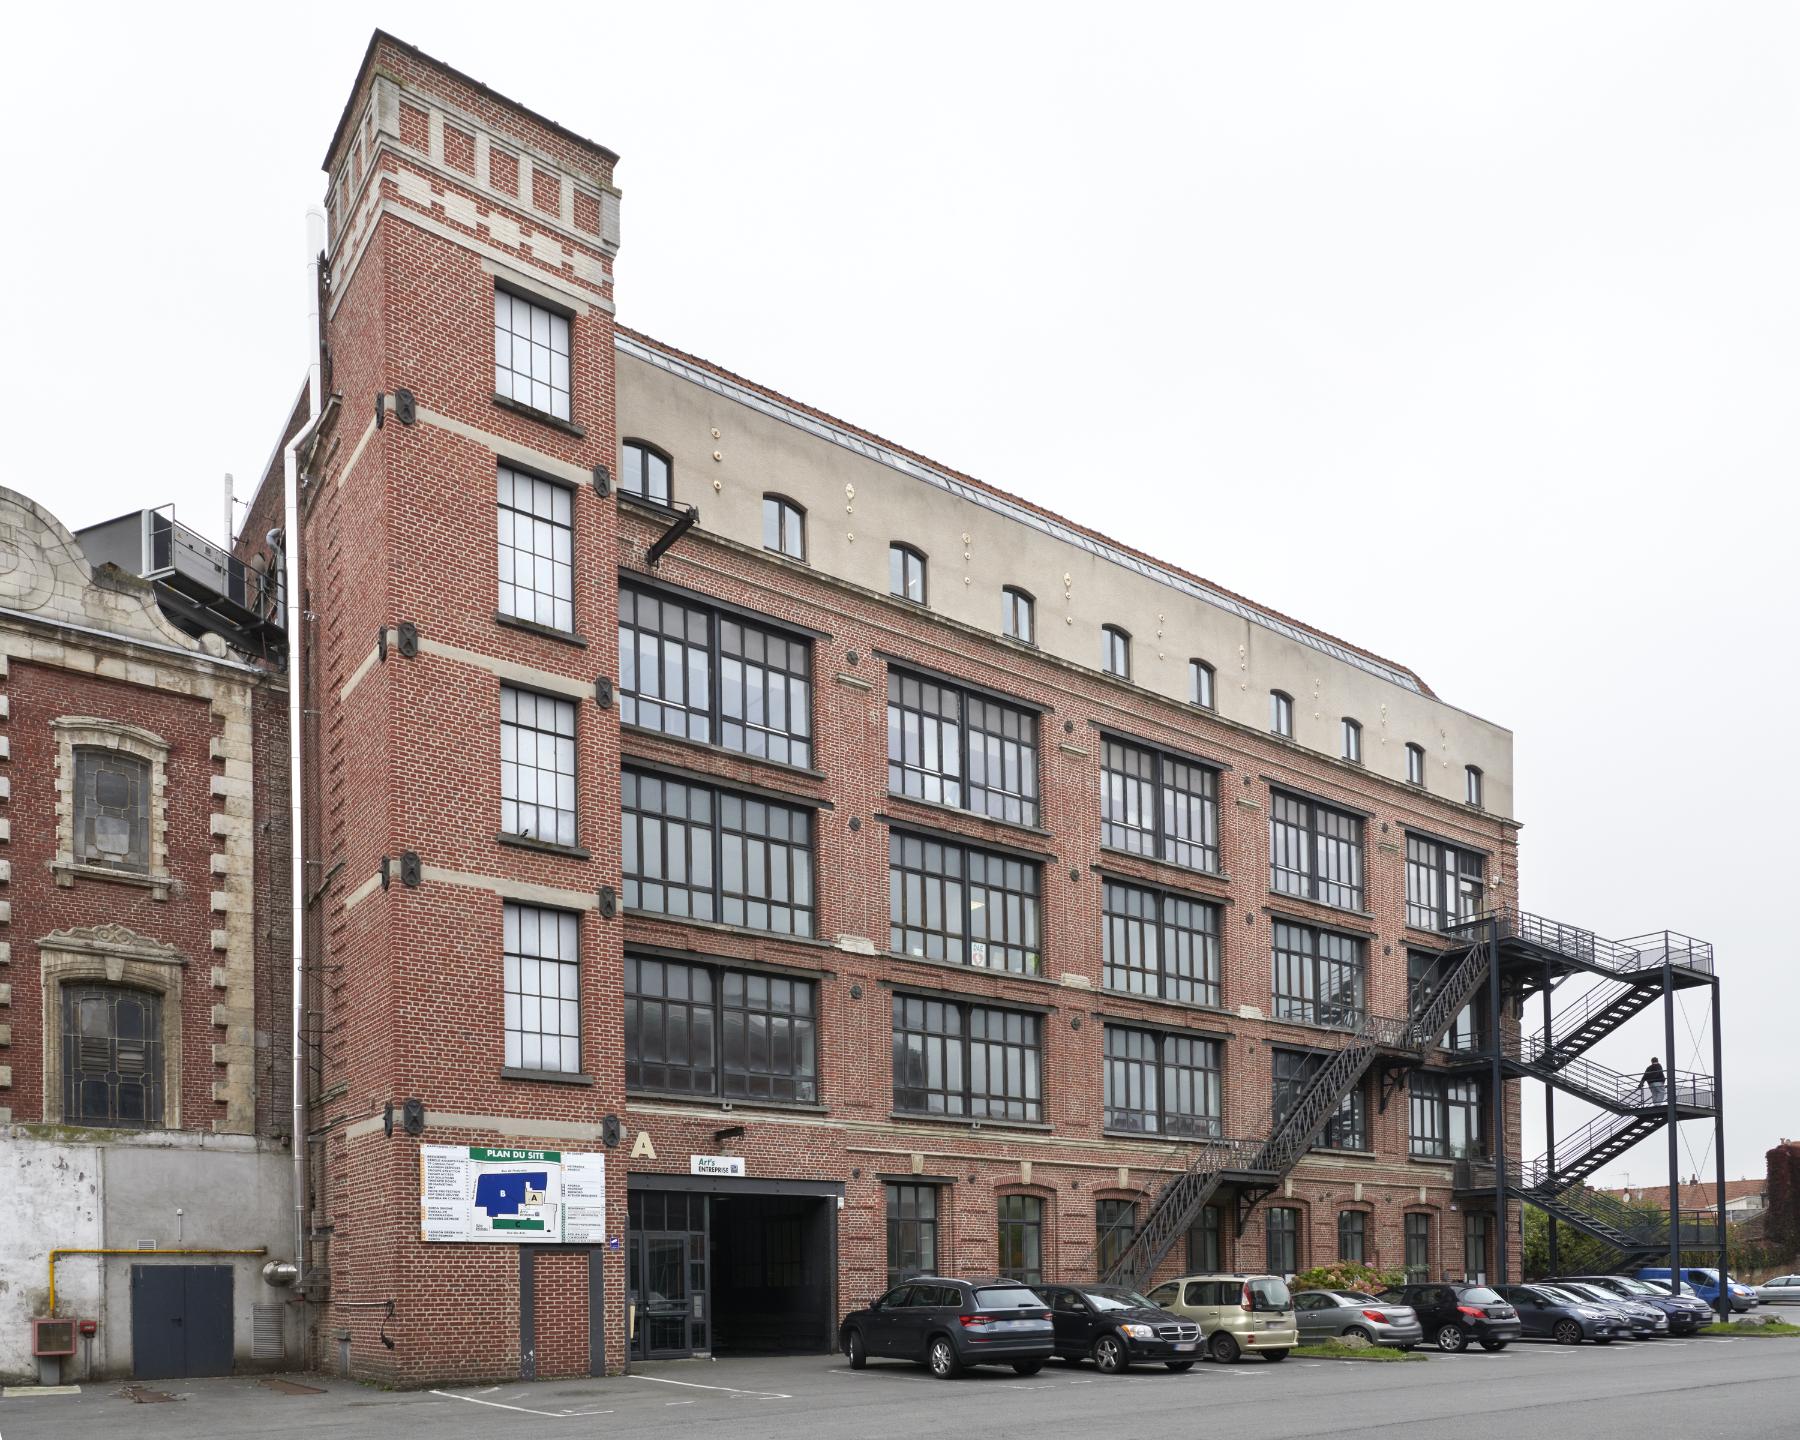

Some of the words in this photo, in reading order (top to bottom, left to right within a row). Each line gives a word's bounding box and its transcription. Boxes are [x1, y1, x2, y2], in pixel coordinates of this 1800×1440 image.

[630, 1131, 657, 1159] A
[487, 1150, 511, 1158] PLAN
[513, 1151, 525, 1159] DU
[528, 1152, 545, 1160] SITE
[698, 1158, 716, 1166] Art's
[698, 1165, 729, 1174] ENTREPRISE
